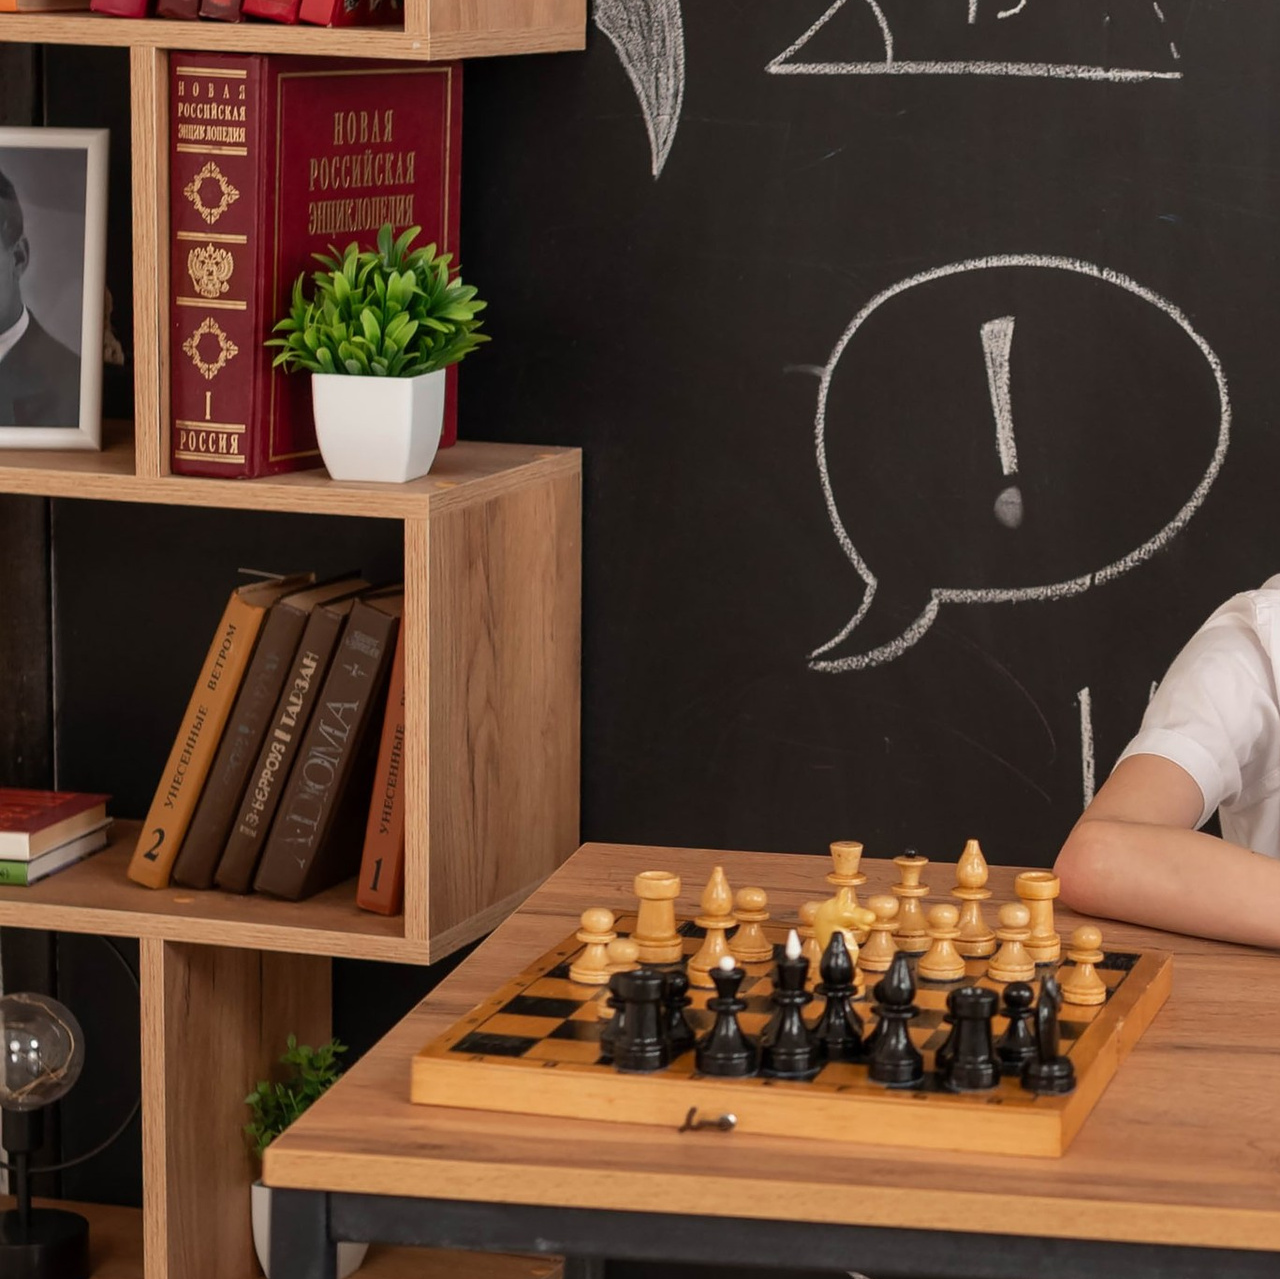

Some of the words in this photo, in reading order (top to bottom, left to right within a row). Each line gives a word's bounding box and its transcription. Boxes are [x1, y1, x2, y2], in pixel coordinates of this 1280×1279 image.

[177, 102, 246, 122] РОССИЙСКАЯ
[333, 109, 394, 146] НОВАЯ
[178, 124, 246, 143] ЭНЦИКЛОПЕДИЯ
[308, 149, 416, 192] РОССИЙСКАЯ
[307, 194, 415, 238] ЭНЦИКЛОПЕДИЯ
[180, 430, 239, 454] РОССИЯ
[163, 704, 209, 810] УНЕСЕННЫЕ
[206, 622, 237, 692] ВЕТРОМ
[143, 827, 166, 862] 2
[369, 857, 384, 893] 1
